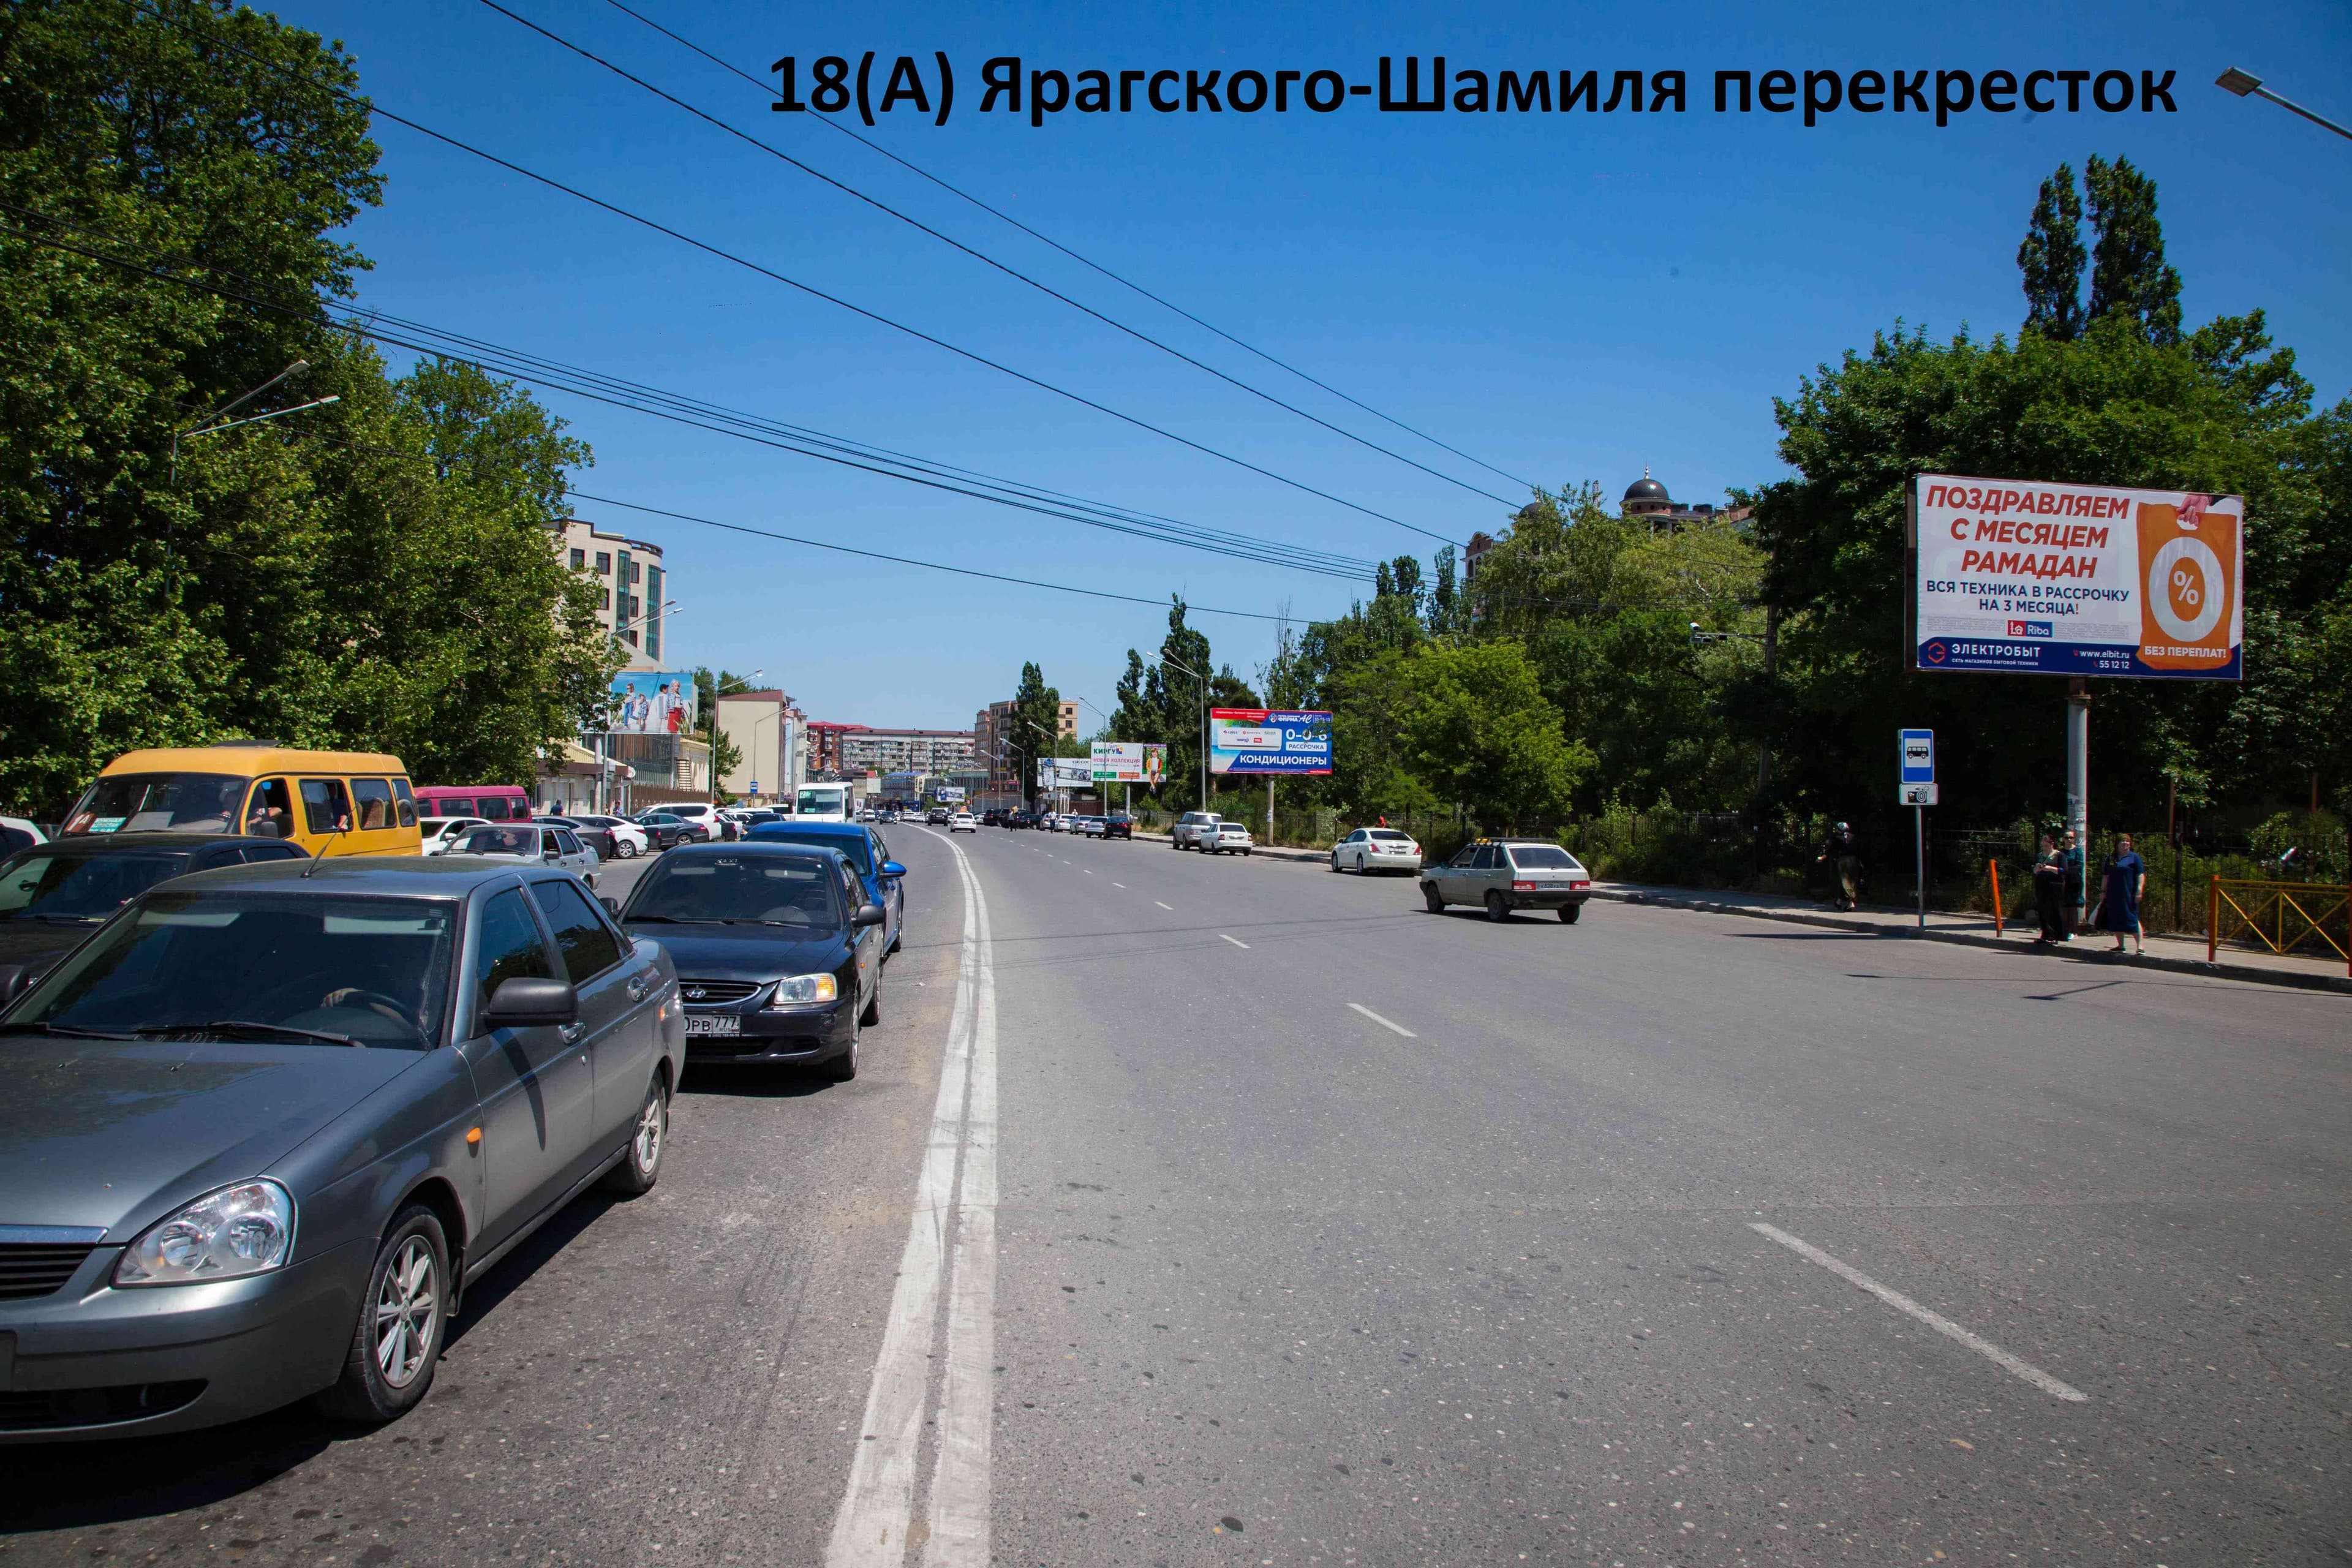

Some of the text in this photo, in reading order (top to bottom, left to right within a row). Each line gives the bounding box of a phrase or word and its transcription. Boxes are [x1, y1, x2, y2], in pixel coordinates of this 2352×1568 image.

[1926, 485, 2130, 519] ПОЗДРАВЛЯЕМ
[1951, 518, 2109, 550] С МЕСЯЦЕМ
[1961, 550, 2098, 580] РАМАДАН
[1927, 581, 2130, 601] ВСЯ ТЕХНИКА В РАССРОЧКУ
[1979, 598, 2078, 616] НА 3 МЕСЯЦА!
[2027, 625, 2049, 635] Riba
[1951, 644, 2040, 657] ЭЛЕКТРОБЫТ
[2079, 649, 2130, 659] www.elbit.ru
[2145, 646, 2226, 658] БЕЗ ПЕРЕПЛАТ!
[1240, 755, 1327, 765] КОНДИЦИОНЕРЫ
[714, 1017, 737, 1028] 777
